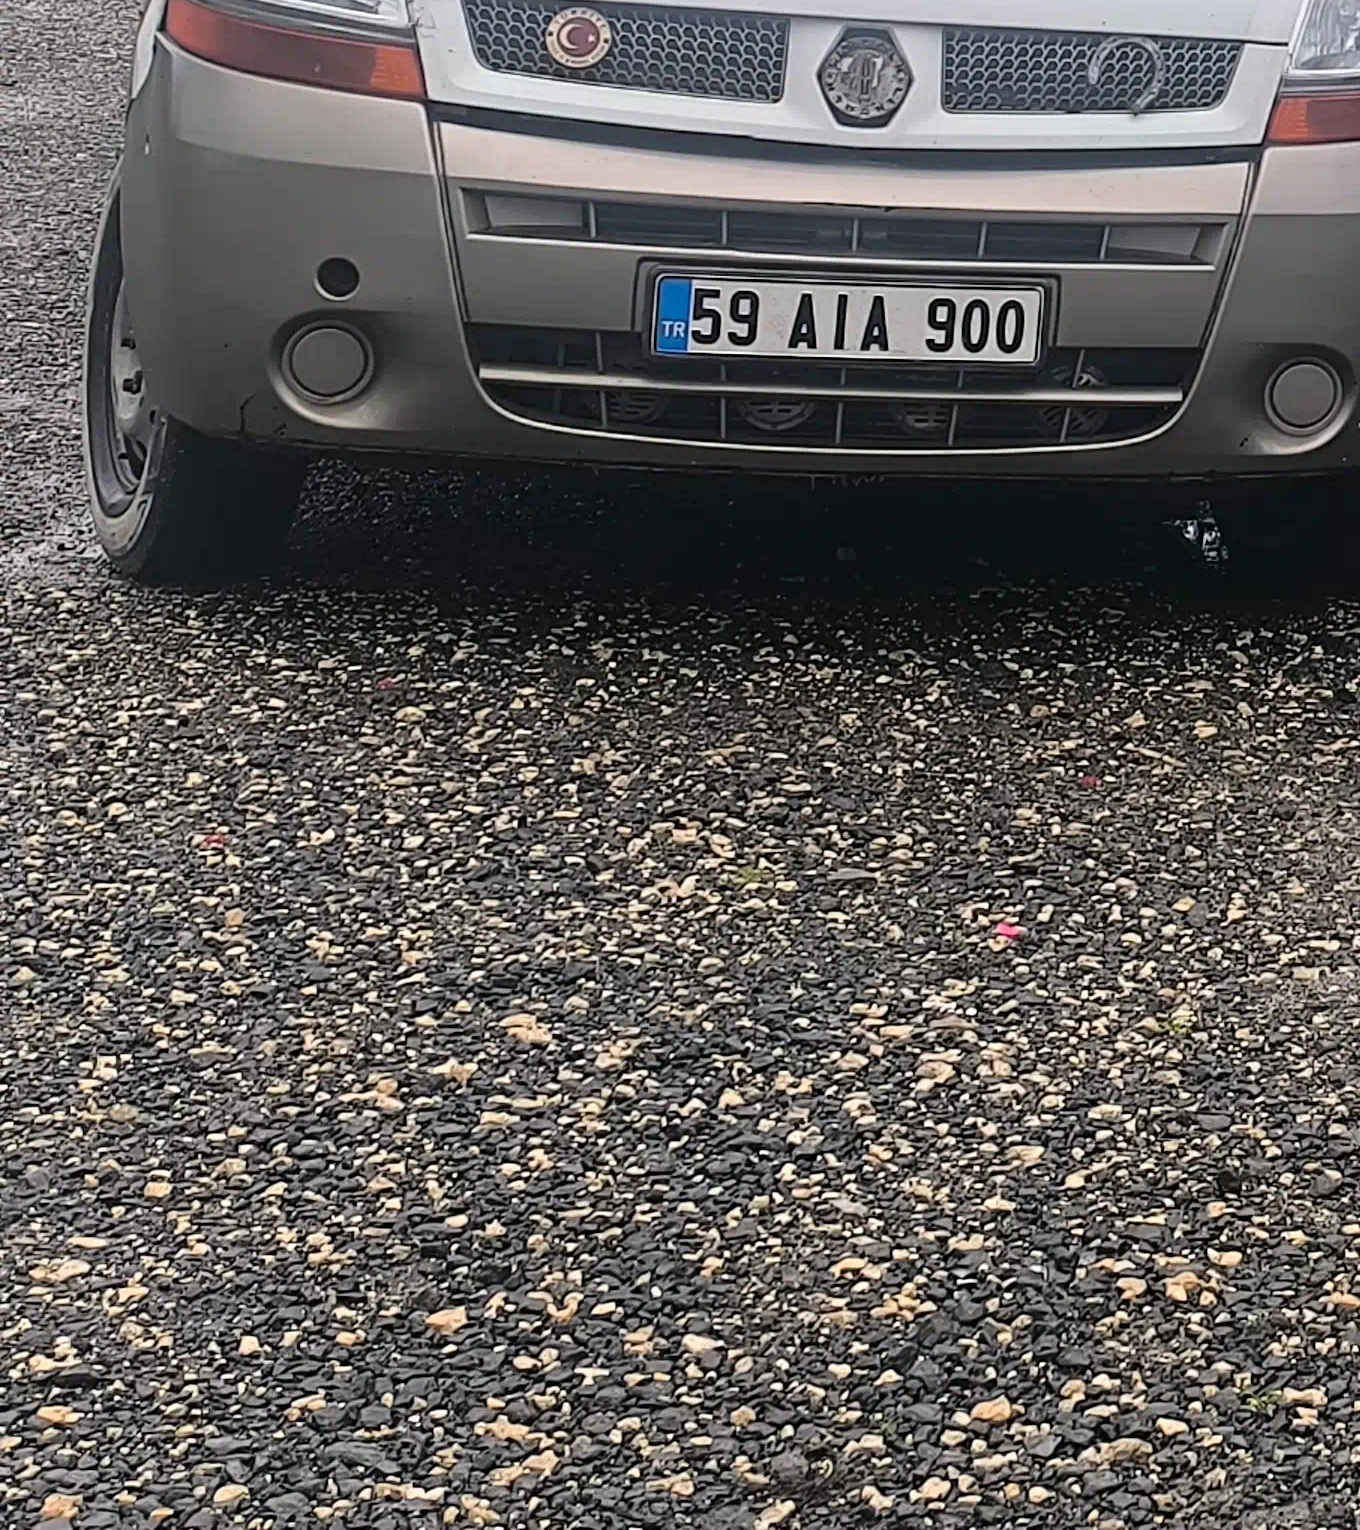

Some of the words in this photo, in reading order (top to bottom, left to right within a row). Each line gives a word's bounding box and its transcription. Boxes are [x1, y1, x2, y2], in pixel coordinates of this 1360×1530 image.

[660, 320, 686, 339] TR
[691, 287, 760, 347] 59
[788, 292, 890, 352] AIA
[925, 297, 1025, 355] 900
